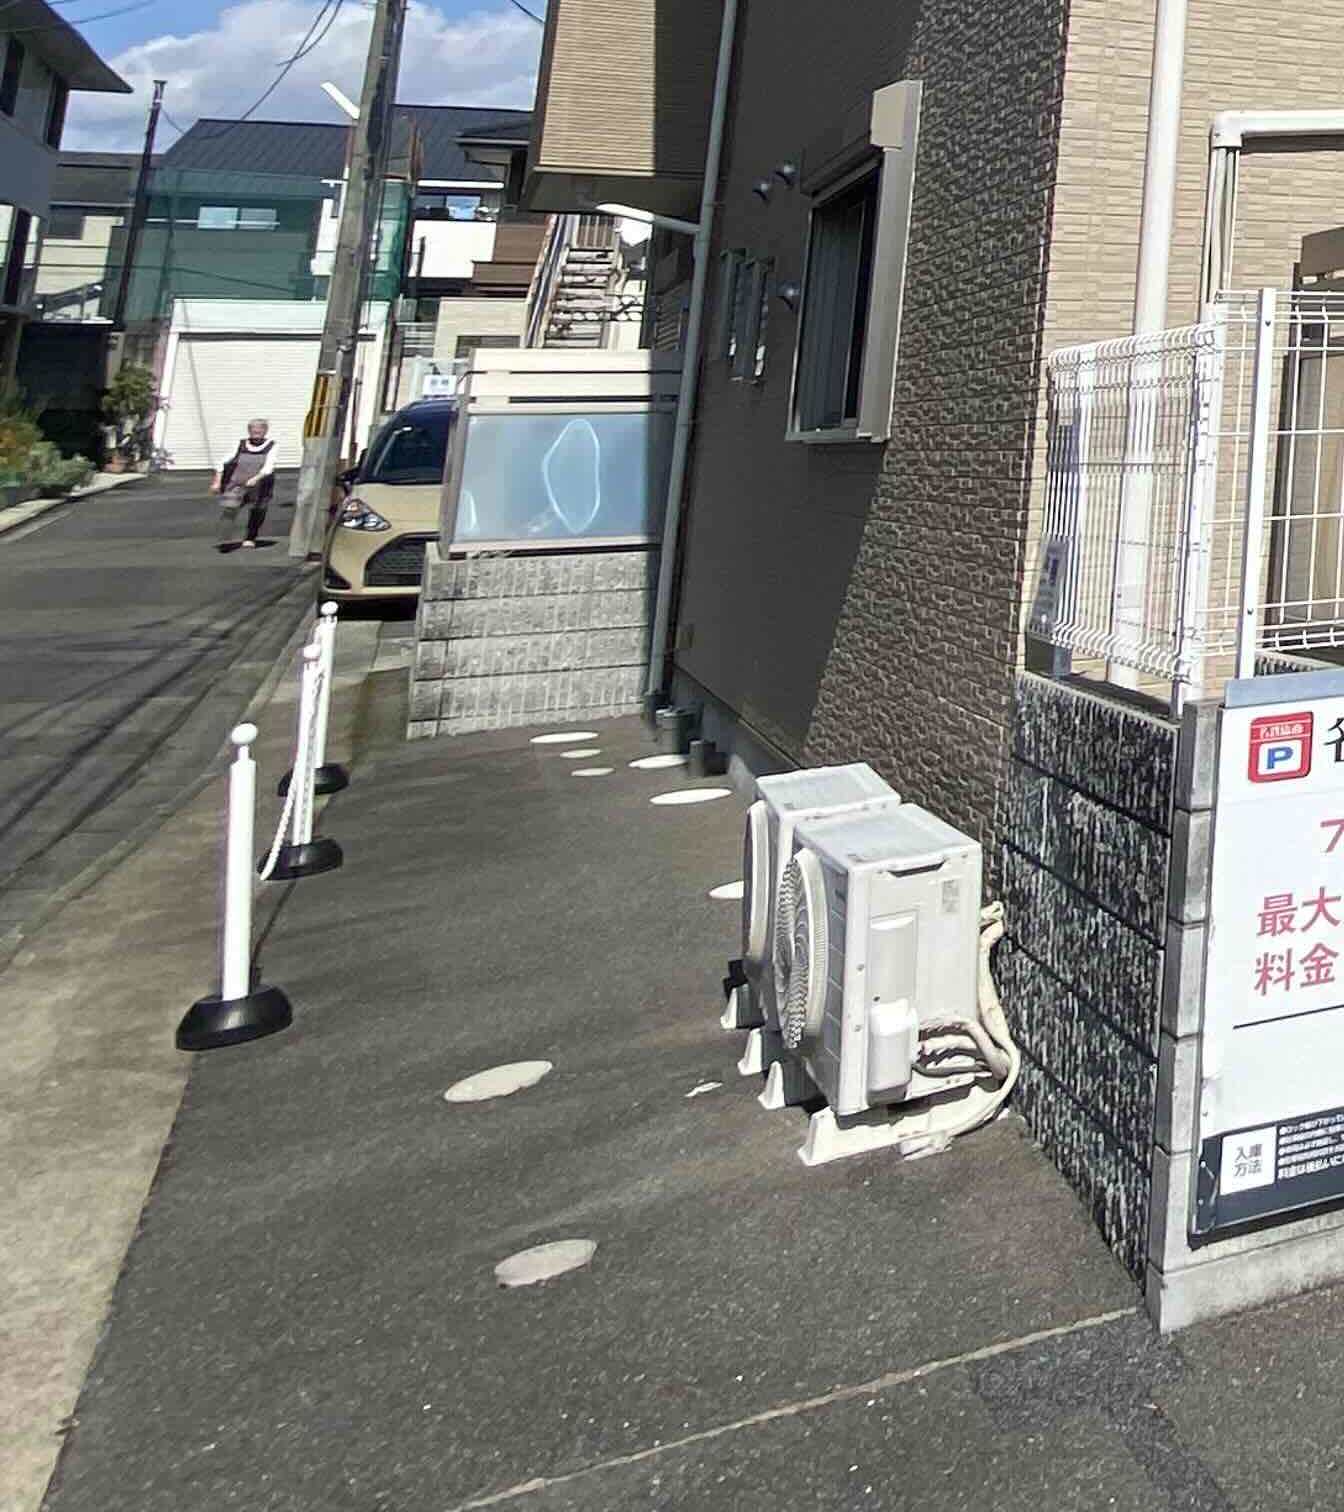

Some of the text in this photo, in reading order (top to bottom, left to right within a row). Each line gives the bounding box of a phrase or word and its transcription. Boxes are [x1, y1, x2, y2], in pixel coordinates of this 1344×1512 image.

[1266, 746, 1294, 769] P
[1256, 886, 1342, 938] 最大
[1255, 942, 1339, 996] 料金
